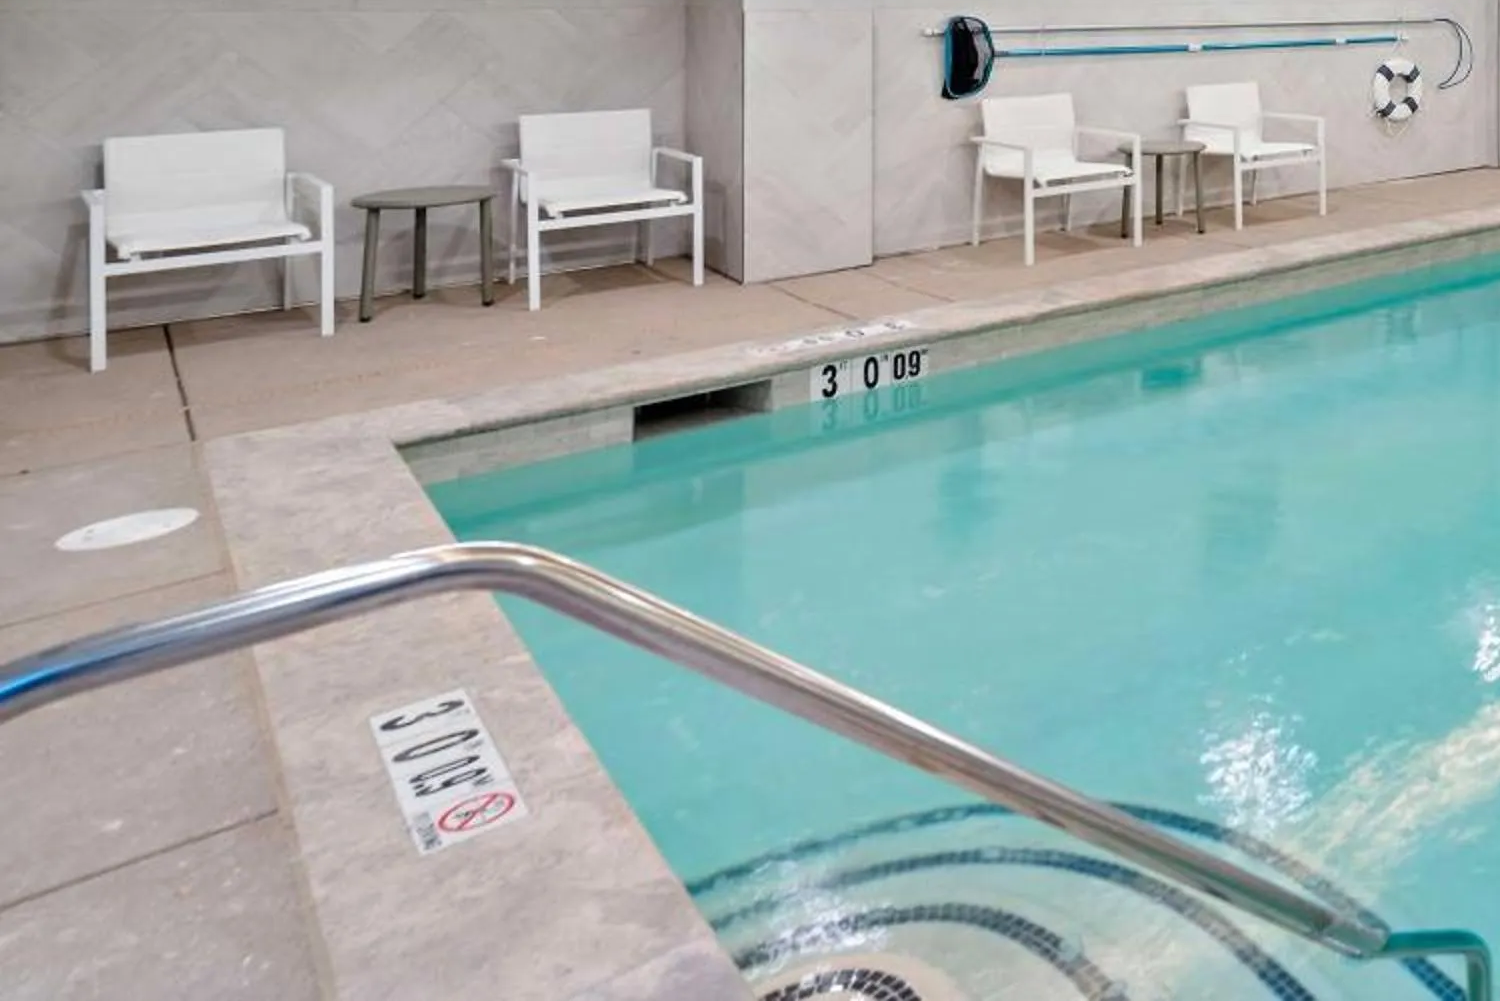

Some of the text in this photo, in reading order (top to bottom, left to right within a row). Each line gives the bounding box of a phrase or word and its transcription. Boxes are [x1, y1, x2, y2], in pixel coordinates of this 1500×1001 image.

[822, 364, 838, 398] 3
[863, 356, 879, 390] 0
[379, 699, 465, 731] 3
[392, 728, 479, 763] 0
